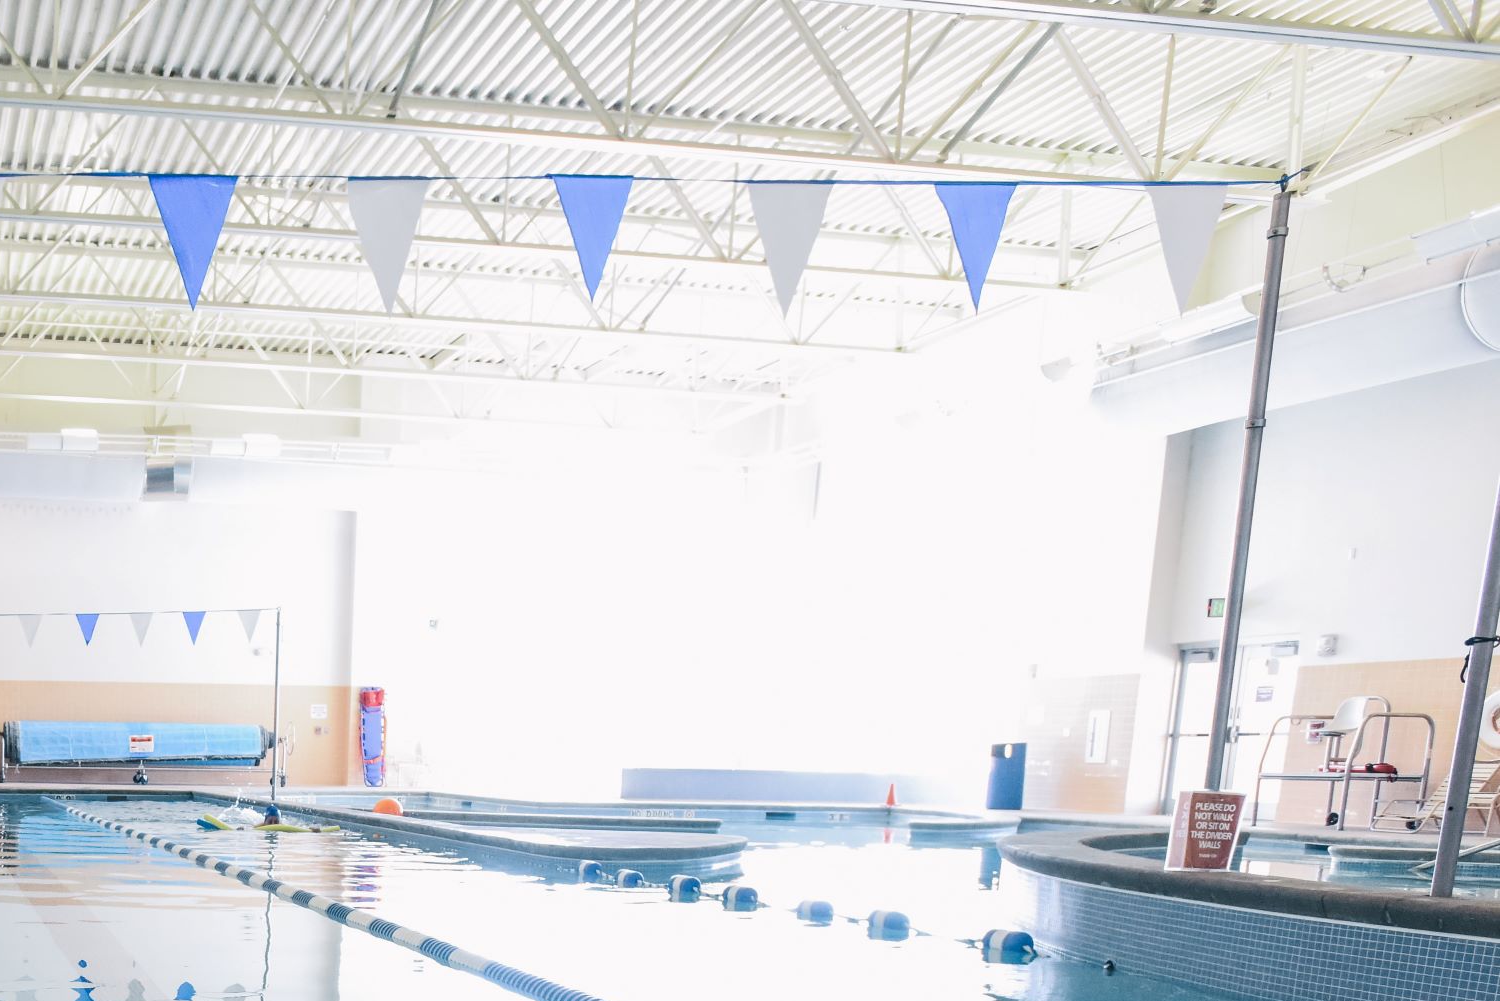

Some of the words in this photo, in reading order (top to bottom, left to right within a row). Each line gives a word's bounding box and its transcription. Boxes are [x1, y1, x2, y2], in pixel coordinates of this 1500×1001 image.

[1195, 802, 1223, 811] PLEASE
[1223, 804, 1237, 812] DO
[1194, 811, 1212, 820] NOT
[1212, 812, 1235, 822] WALK
[1195, 821, 1207, 830] OR
[1207, 822, 1218, 830] SIT
[1218, 822, 1230, 830] ON
[1190, 830, 1205, 839] THE
[1205, 831, 1233, 840] DIVIDER
[1198, 840, 1221, 849] WALLS
